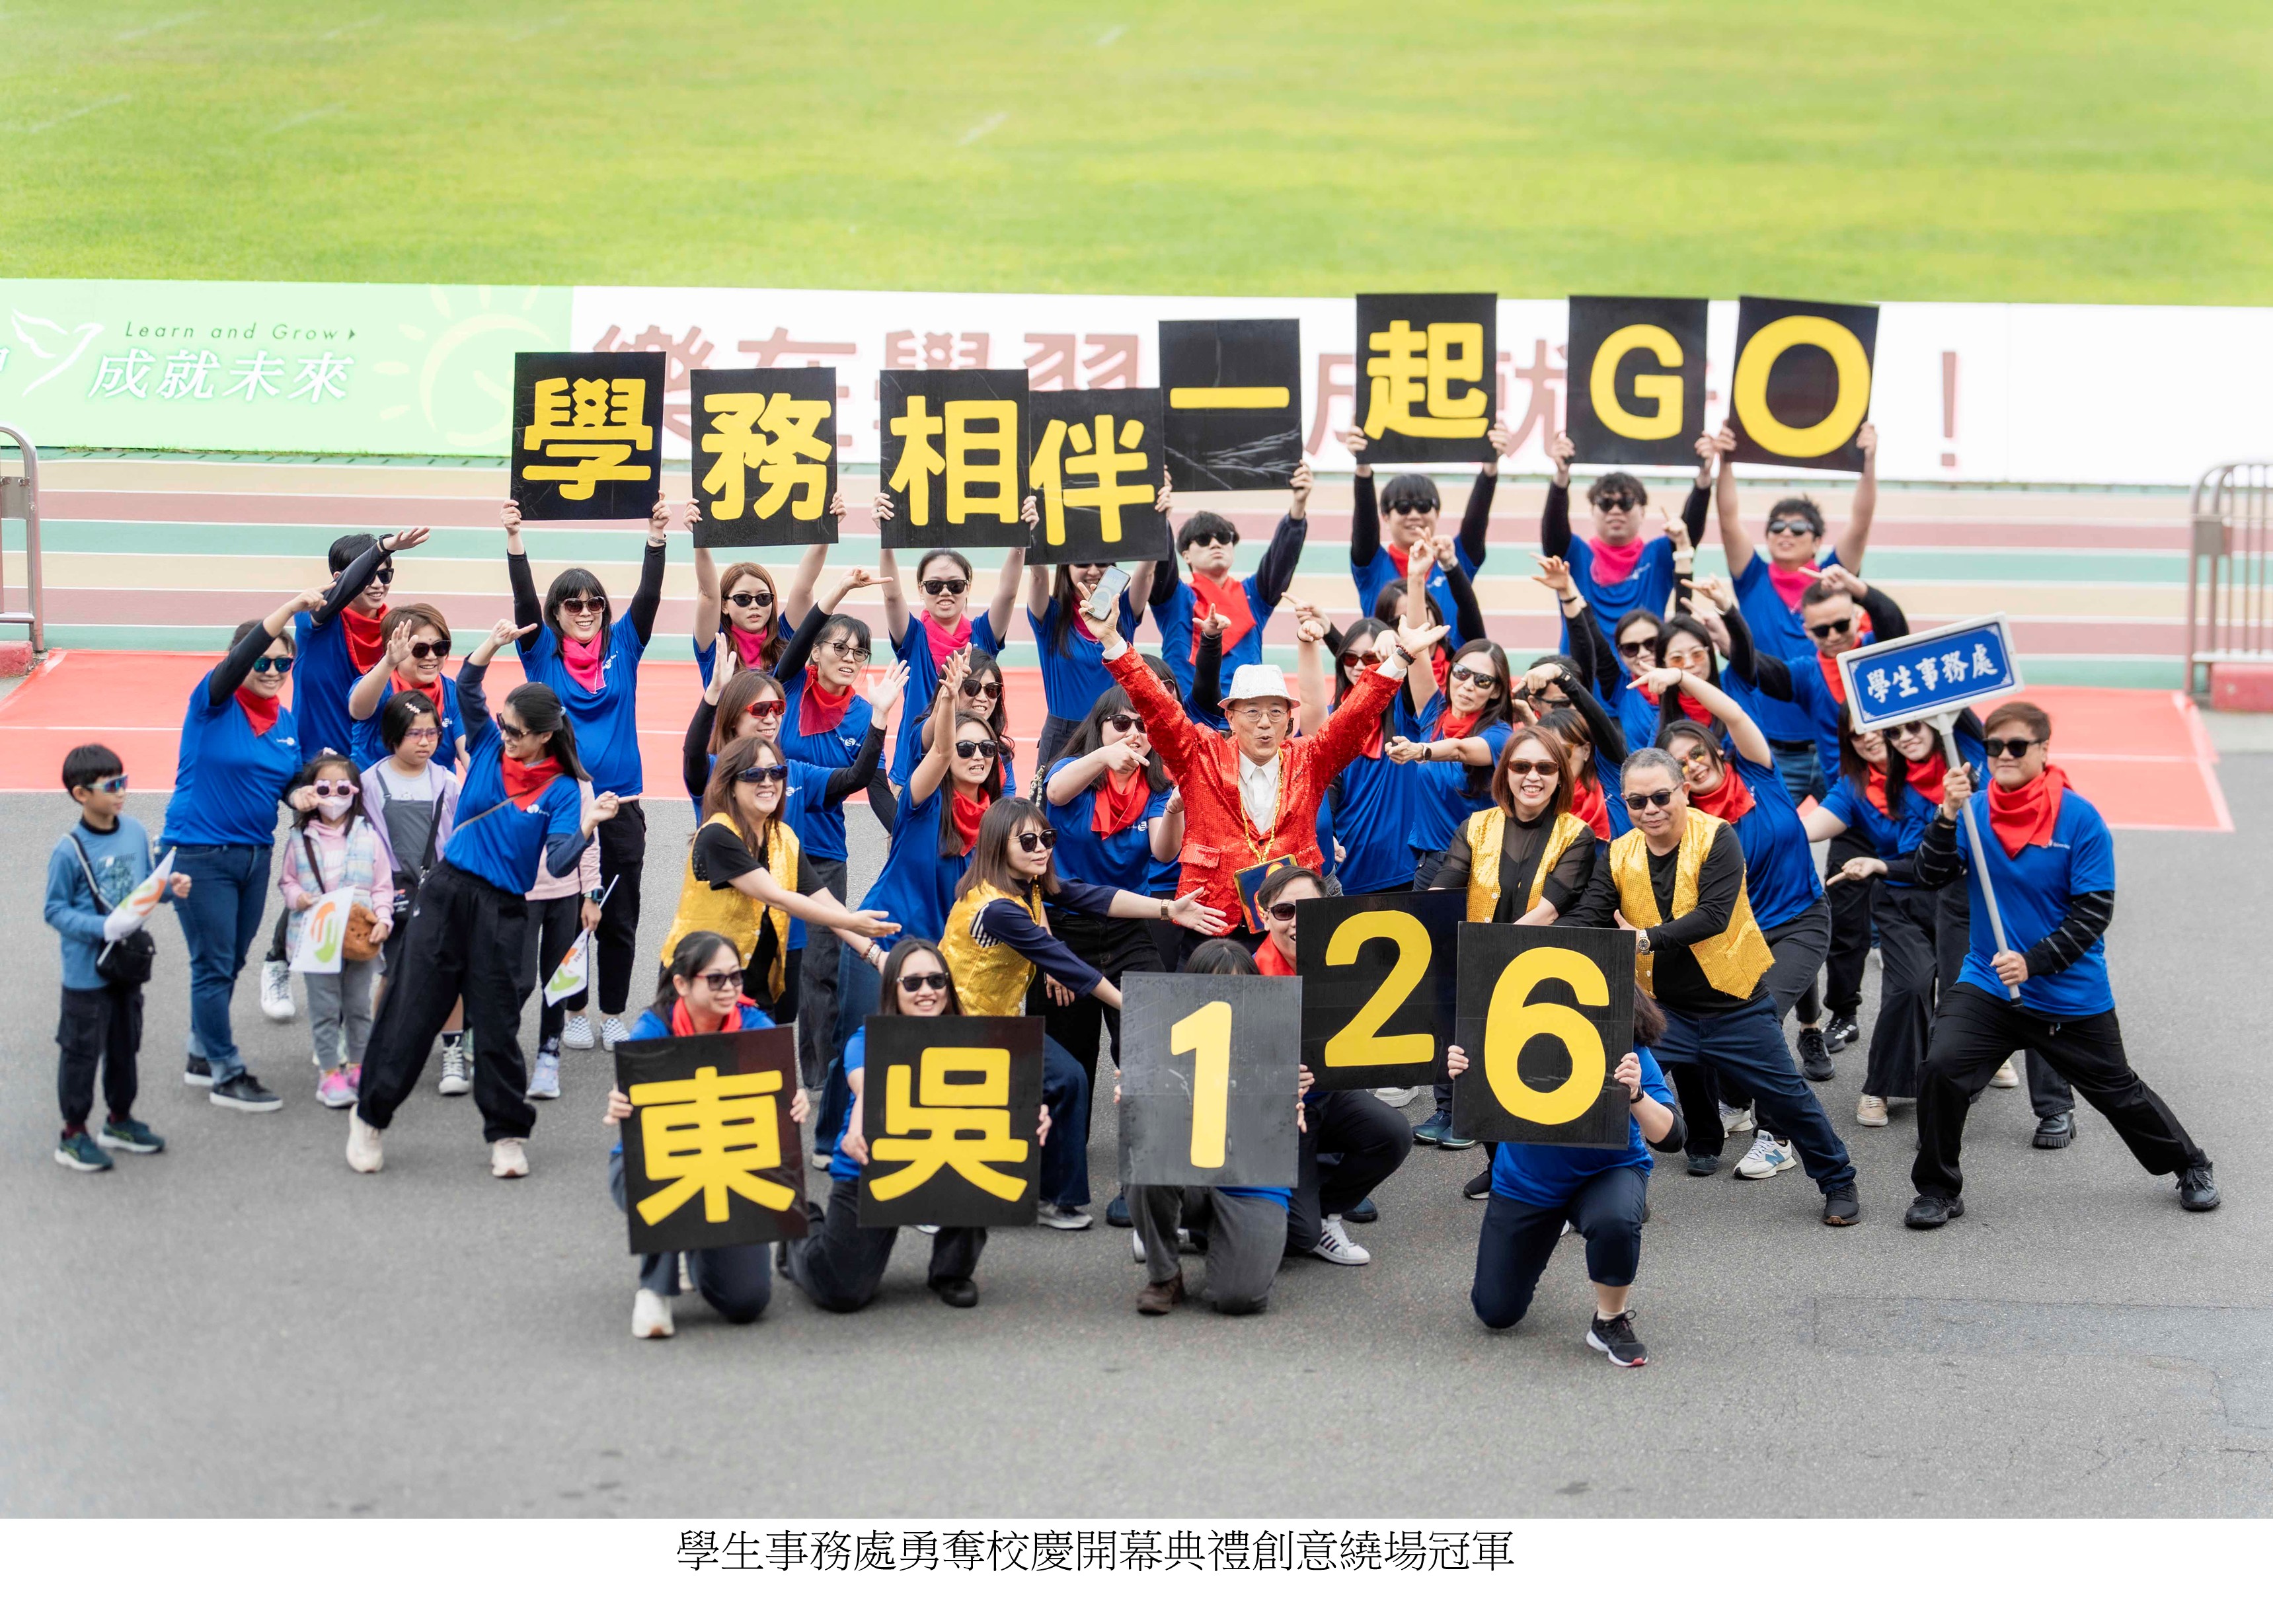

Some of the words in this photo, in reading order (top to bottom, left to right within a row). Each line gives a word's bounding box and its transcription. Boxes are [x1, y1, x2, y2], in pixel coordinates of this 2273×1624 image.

[88, 347, 355, 403] 成就未來
[125, 321, 194, 338] Learn
[211, 322, 256, 340] and
[272, 323, 339, 340] Grow
[1364, 320, 1489, 440] 起
[1590, 324, 1684, 440] G
[522, 377, 652, 500] 學
[701, 393, 831, 521] 務
[889, 395, 1019, 526] 相
[1029, 414, 1155, 546] 伴
[1867, 643, 1999, 703] 學生事務處
[1324, 909, 1435, 1067] 2
[1484, 946, 1609, 1126] 6
[629, 1065, 796, 1227] 東
[868, 1047, 1028, 1202] 吳
[1170, 1001, 1232, 1169] 1
